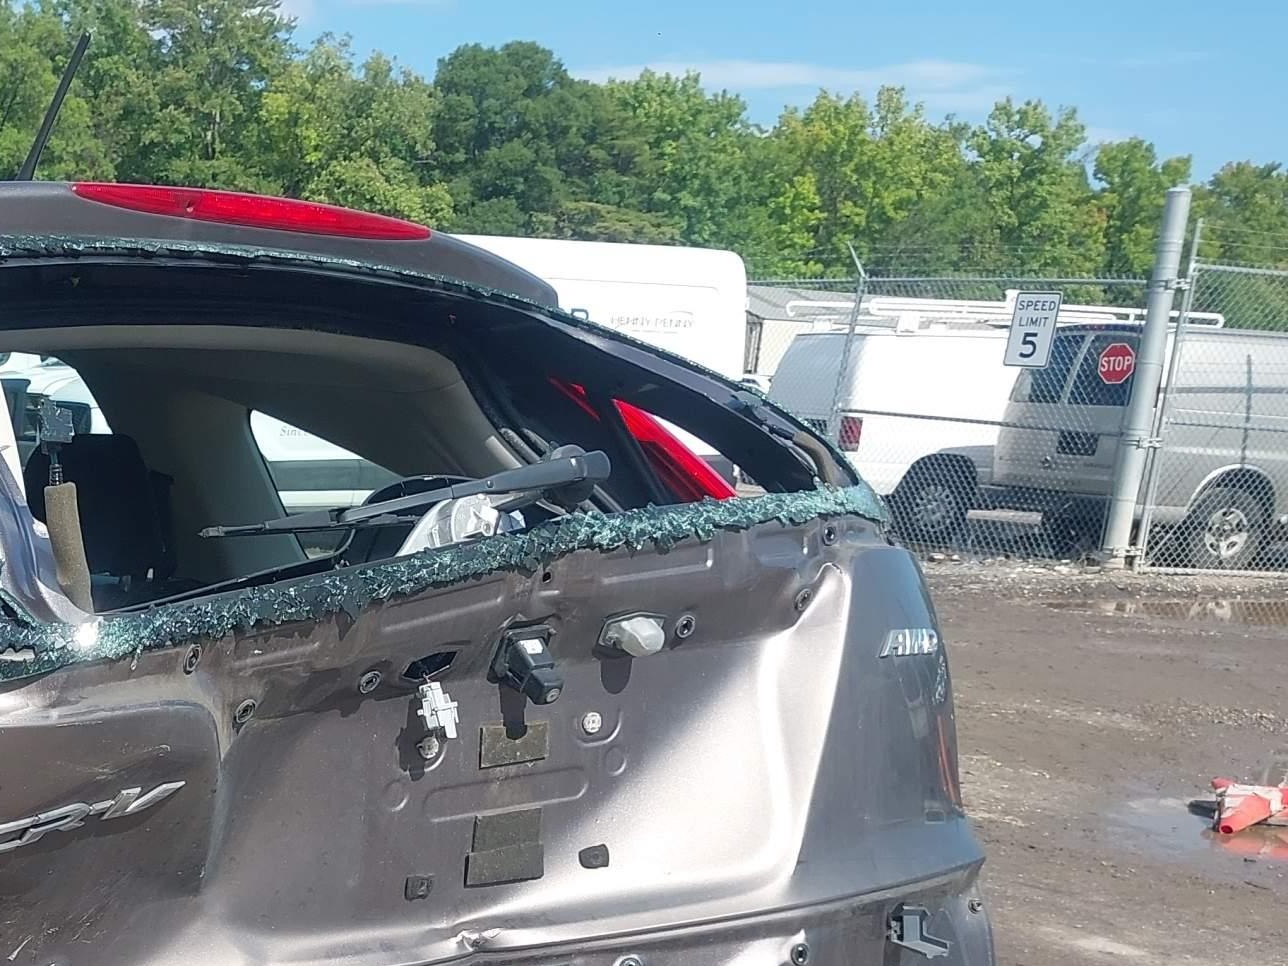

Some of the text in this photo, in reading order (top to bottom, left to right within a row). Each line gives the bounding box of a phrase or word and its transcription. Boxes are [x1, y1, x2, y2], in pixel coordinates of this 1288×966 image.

[1018, 300, 1056, 311] SPEED
[1018, 316, 1049, 327] LIMIT
[1018, 332, 1038, 358] 5
[1100, 355, 1132, 372] STOP
